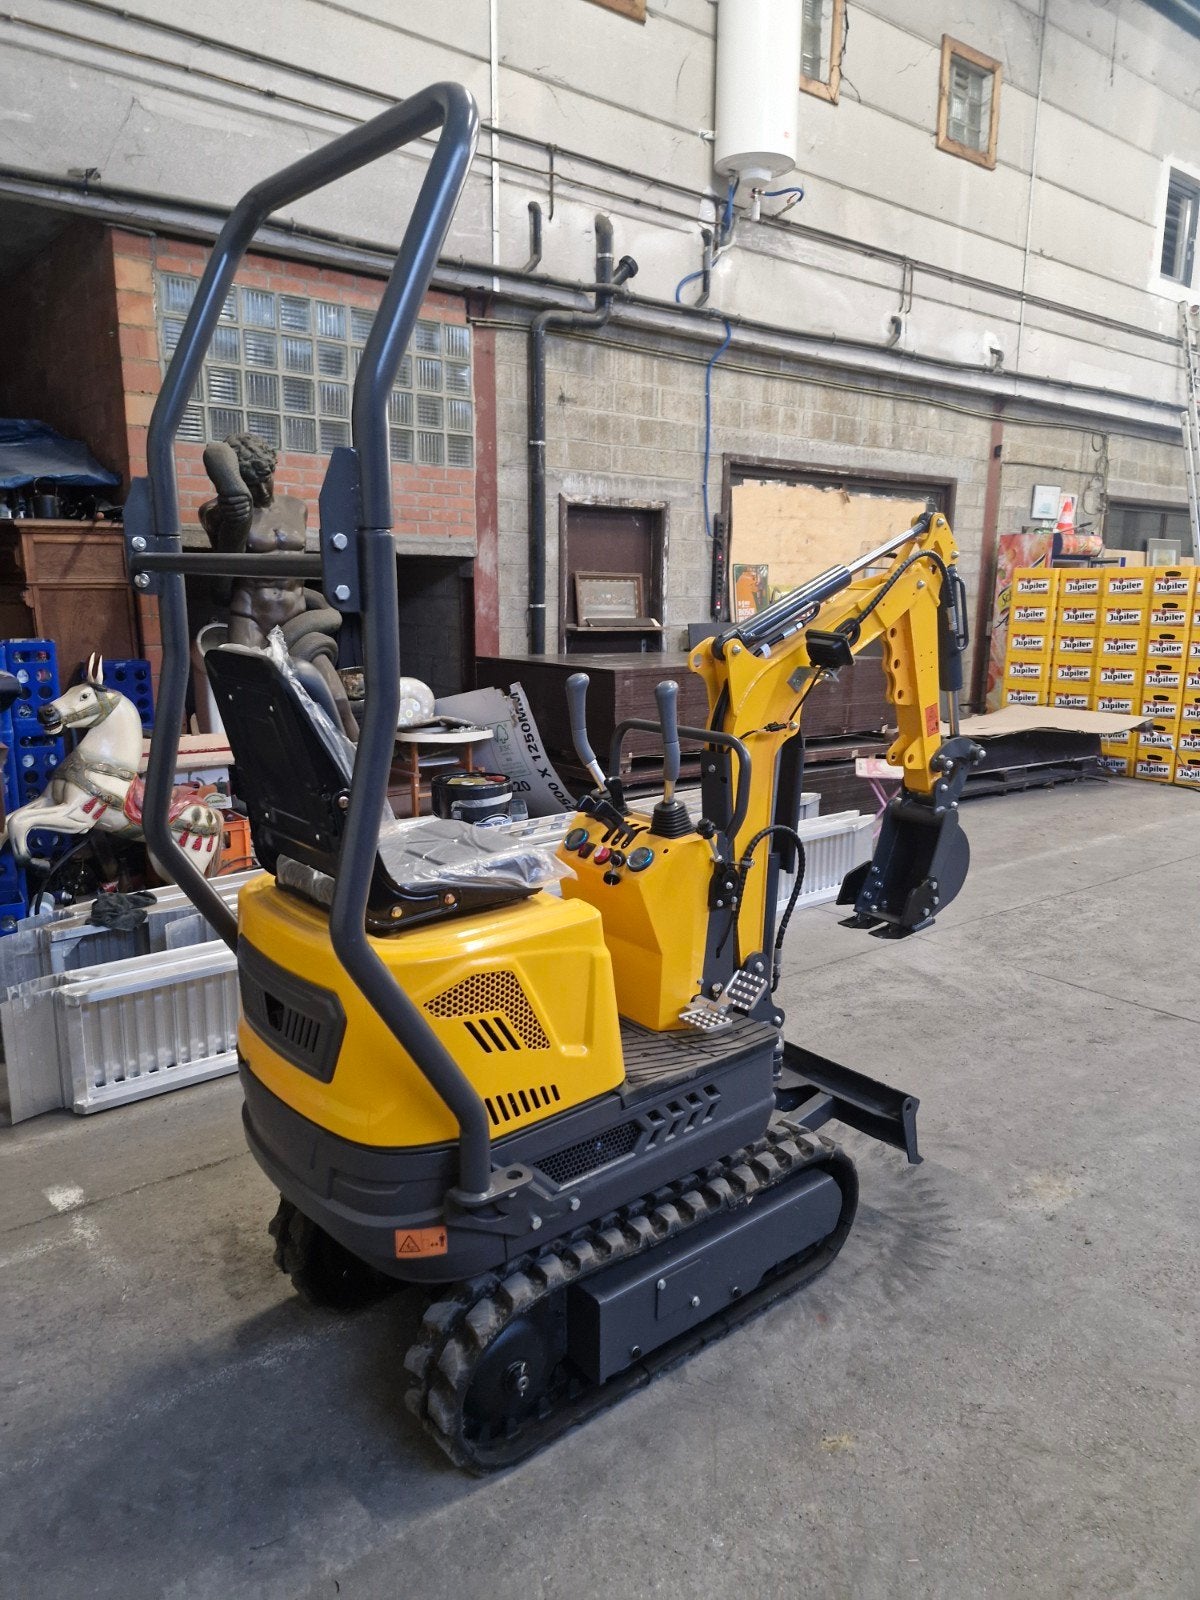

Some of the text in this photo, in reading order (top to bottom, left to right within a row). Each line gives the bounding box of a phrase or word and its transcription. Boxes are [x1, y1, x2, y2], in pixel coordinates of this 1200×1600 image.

[1021, 582, 1047, 592] Jupiler
[1069, 582, 1097, 592] Jupiler
[1112, 582, 1142, 591] Jupiler
[1157, 582, 1187, 592] Jupiler
[1017, 611, 1044, 620] Jupiler
[1066, 611, 1094, 621] Jupiler
[1110, 612, 1139, 622] Jupiler
[1154, 613, 1185, 622] Jupiler
[1015, 638, 1041, 647] Jupiler
[1063, 640, 1091, 649] Jupiler
[1107, 642, 1136, 652] Jupiler
[1152, 644, 1182, 653] Jupiler
[1013, 666, 1039, 675] Jupiler
[1061, 668, 1089, 678] Jupiler
[1104, 672, 1133, 682] Jupiler
[1149, 675, 1178, 684] Jupiler
[1010, 693, 1037, 703] Jupiler
[1058, 697, 1087, 707] Jupiler
[1101, 701, 1130, 711] Jupiler
[1146, 705, 1175, 715] Jupiler
[1142, 735, 1172, 744] Jupilr
[1139, 764, 1168, 774] Jupiler
